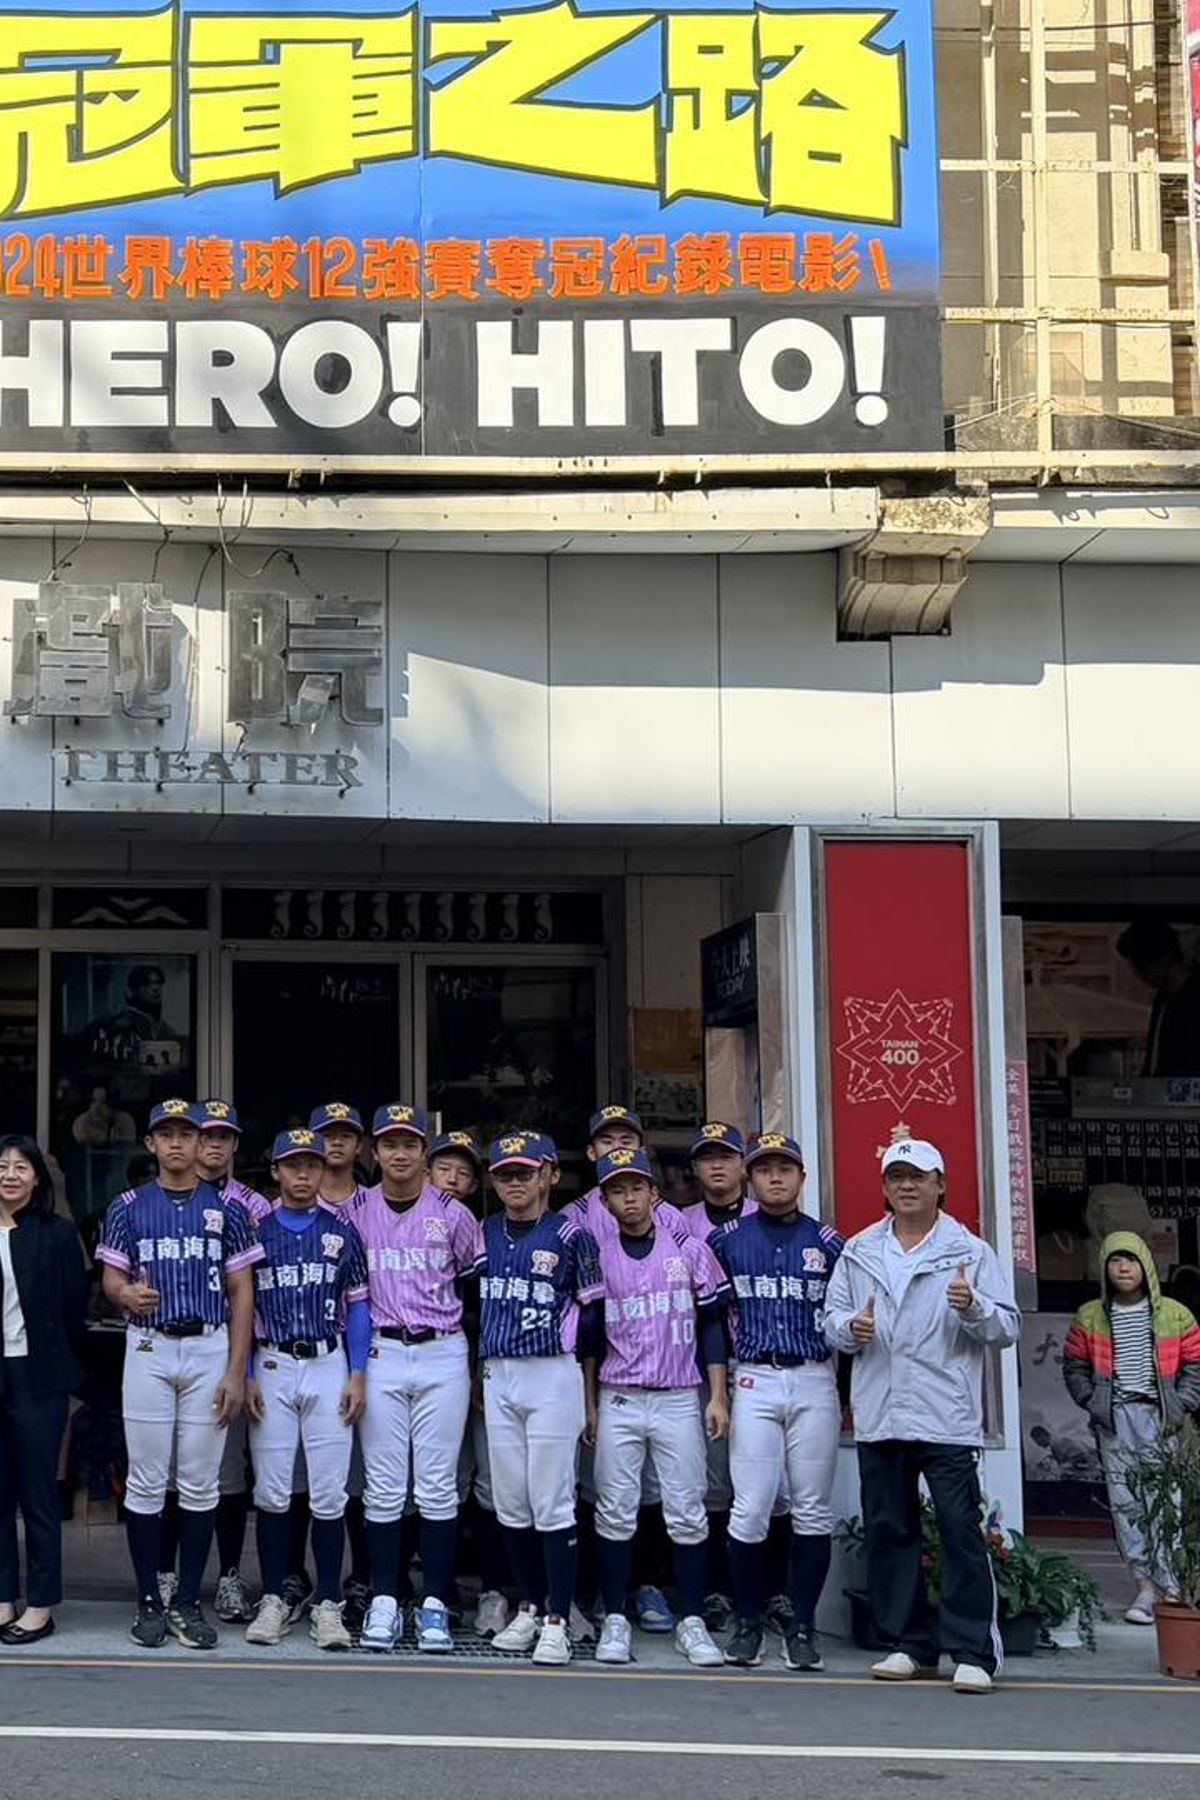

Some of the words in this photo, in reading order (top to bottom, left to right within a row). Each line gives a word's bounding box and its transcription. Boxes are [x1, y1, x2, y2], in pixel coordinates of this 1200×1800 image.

[476, 316, 890, 428] HITO!
[58, 749, 363, 788] THEATER
[880, 1049, 920, 1065] 400
[881, 1039, 920, 1049] TAINAN
